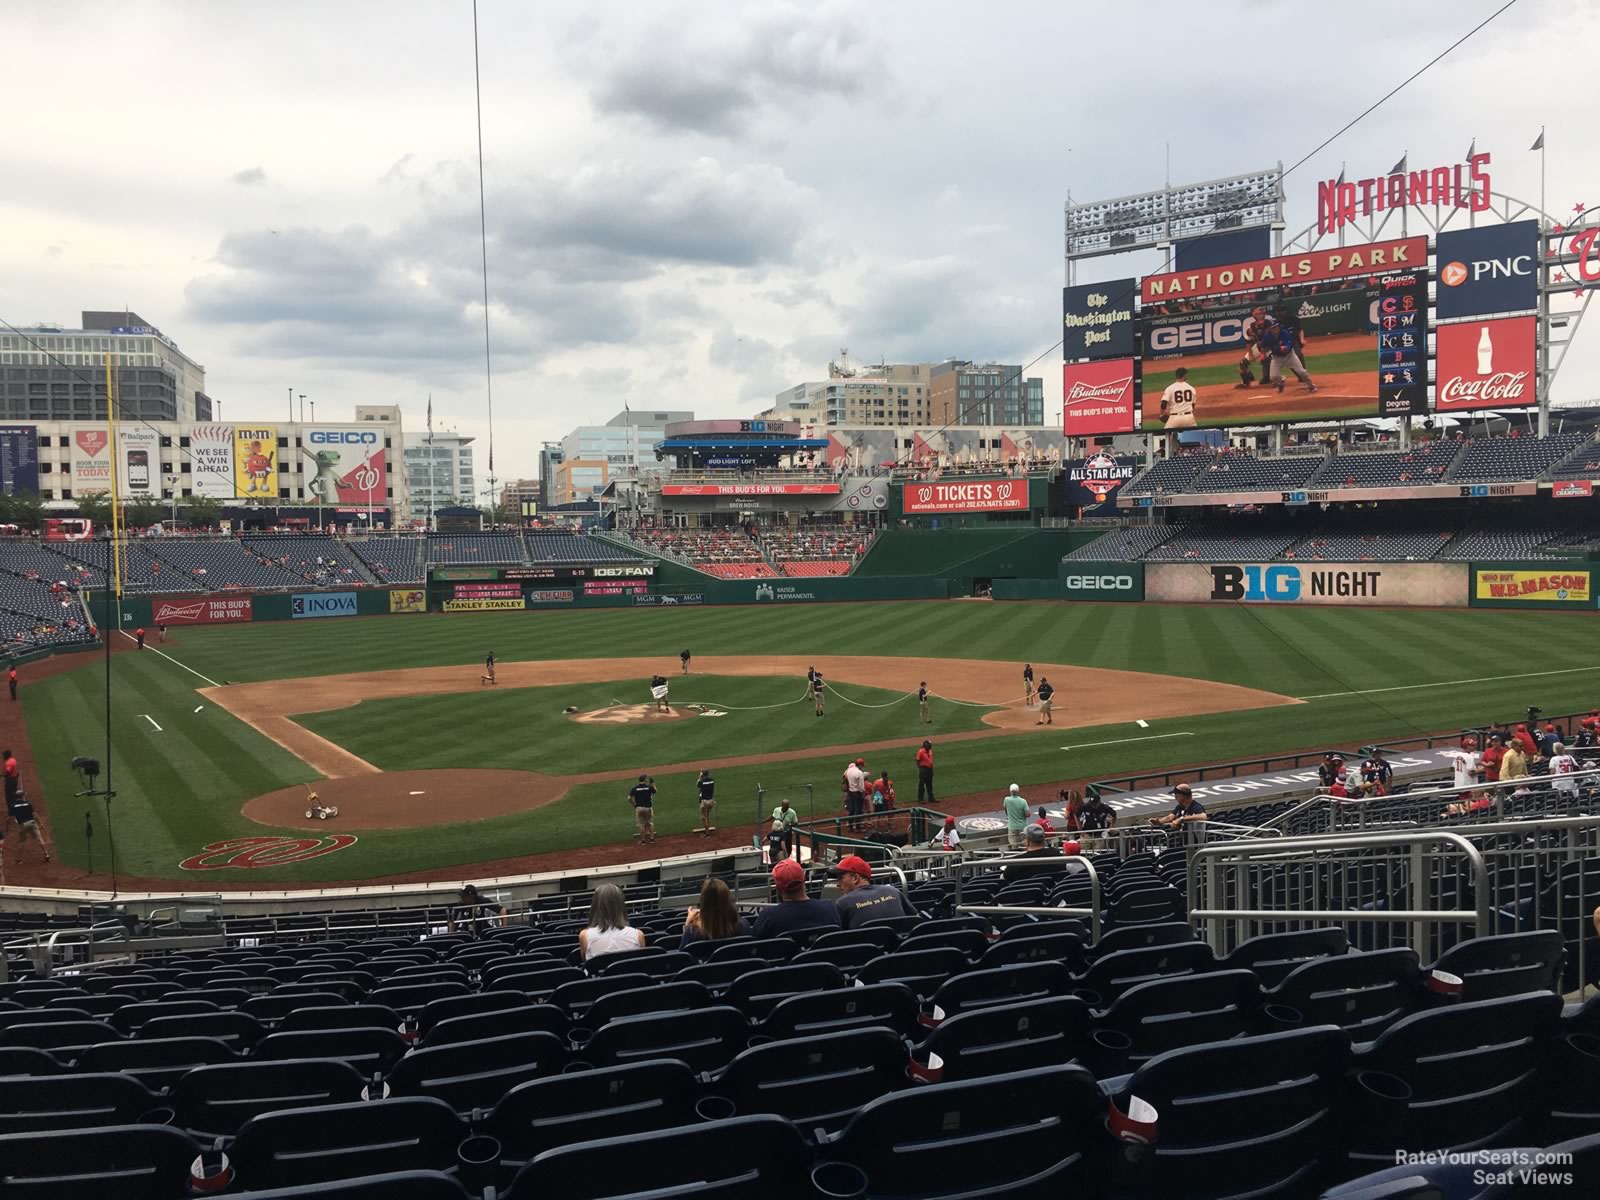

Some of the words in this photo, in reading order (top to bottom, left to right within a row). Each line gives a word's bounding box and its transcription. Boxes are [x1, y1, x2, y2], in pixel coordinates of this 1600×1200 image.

[1318, 152, 1490, 236] NATIONALS
[1150, 259, 1312, 296] NATIONALS
[1328, 245, 1408, 271] PARK
[1472, 255, 1532, 281] PNC
[1381, 274, 1416, 284] QUICK
[1087, 293, 1108, 308] The
[1325, 302, 1352, 313] LIGHT
[1065, 310, 1131, 328] Washington
[1084, 329, 1111, 347] Post
[1070, 385, 1125, 399] Budweiser
[1441, 370, 1530, 403] Coca-Cola
[1174, 389, 1194, 404] 60
[1386, 400, 1411, 408] Degree
[1069, 409, 1083, 417] THIS
[1083, 408, 1101, 416] BUD'S
[1102, 406, 1114, 415] FOR
[1114, 406, 1128, 414] YOU.
[767, 422, 784, 432] NIGHT
[310, 431, 377, 444] GEICO
[196, 448, 211, 456] WE
[213, 448, 228, 456] SEE
[198, 457, 204, 465] A
[76, 469, 110, 477] TODAY
[196, 465, 230, 473] AHEAD
[1070, 469, 1085, 481] ALL
[1086, 468, 1108, 480] STAR
[1109, 467, 1133, 479] GAME
[718, 486, 734, 494] THIS
[734, 486, 756, 494] BUD'S
[757, 485, 770, 493] FOR
[771, 485, 787, 493] YOU.
[936, 484, 992, 501] TICKETS
[1490, 486, 1515, 495] NIGHT
[1307, 491, 1329, 500] NIGHT
[911, 502, 948, 510] nationals.com
[955, 501, 966, 509] call
[625, 567, 654, 576] FAN
[1066, 575, 1133, 590] GEICO
[1481, 574, 1498, 582] WHO
[1311, 571, 1381, 597] NIGHT
[209, 602, 227, 610] THIS
[228, 600, 251, 609] BUD'S
[309, 597, 356, 612] INOVA
[485, 600, 521, 608] STANLEY
[161, 606, 201, 617] Budweiser
[210, 611, 225, 619] FOR
[226, 609, 244, 618] YOU.
